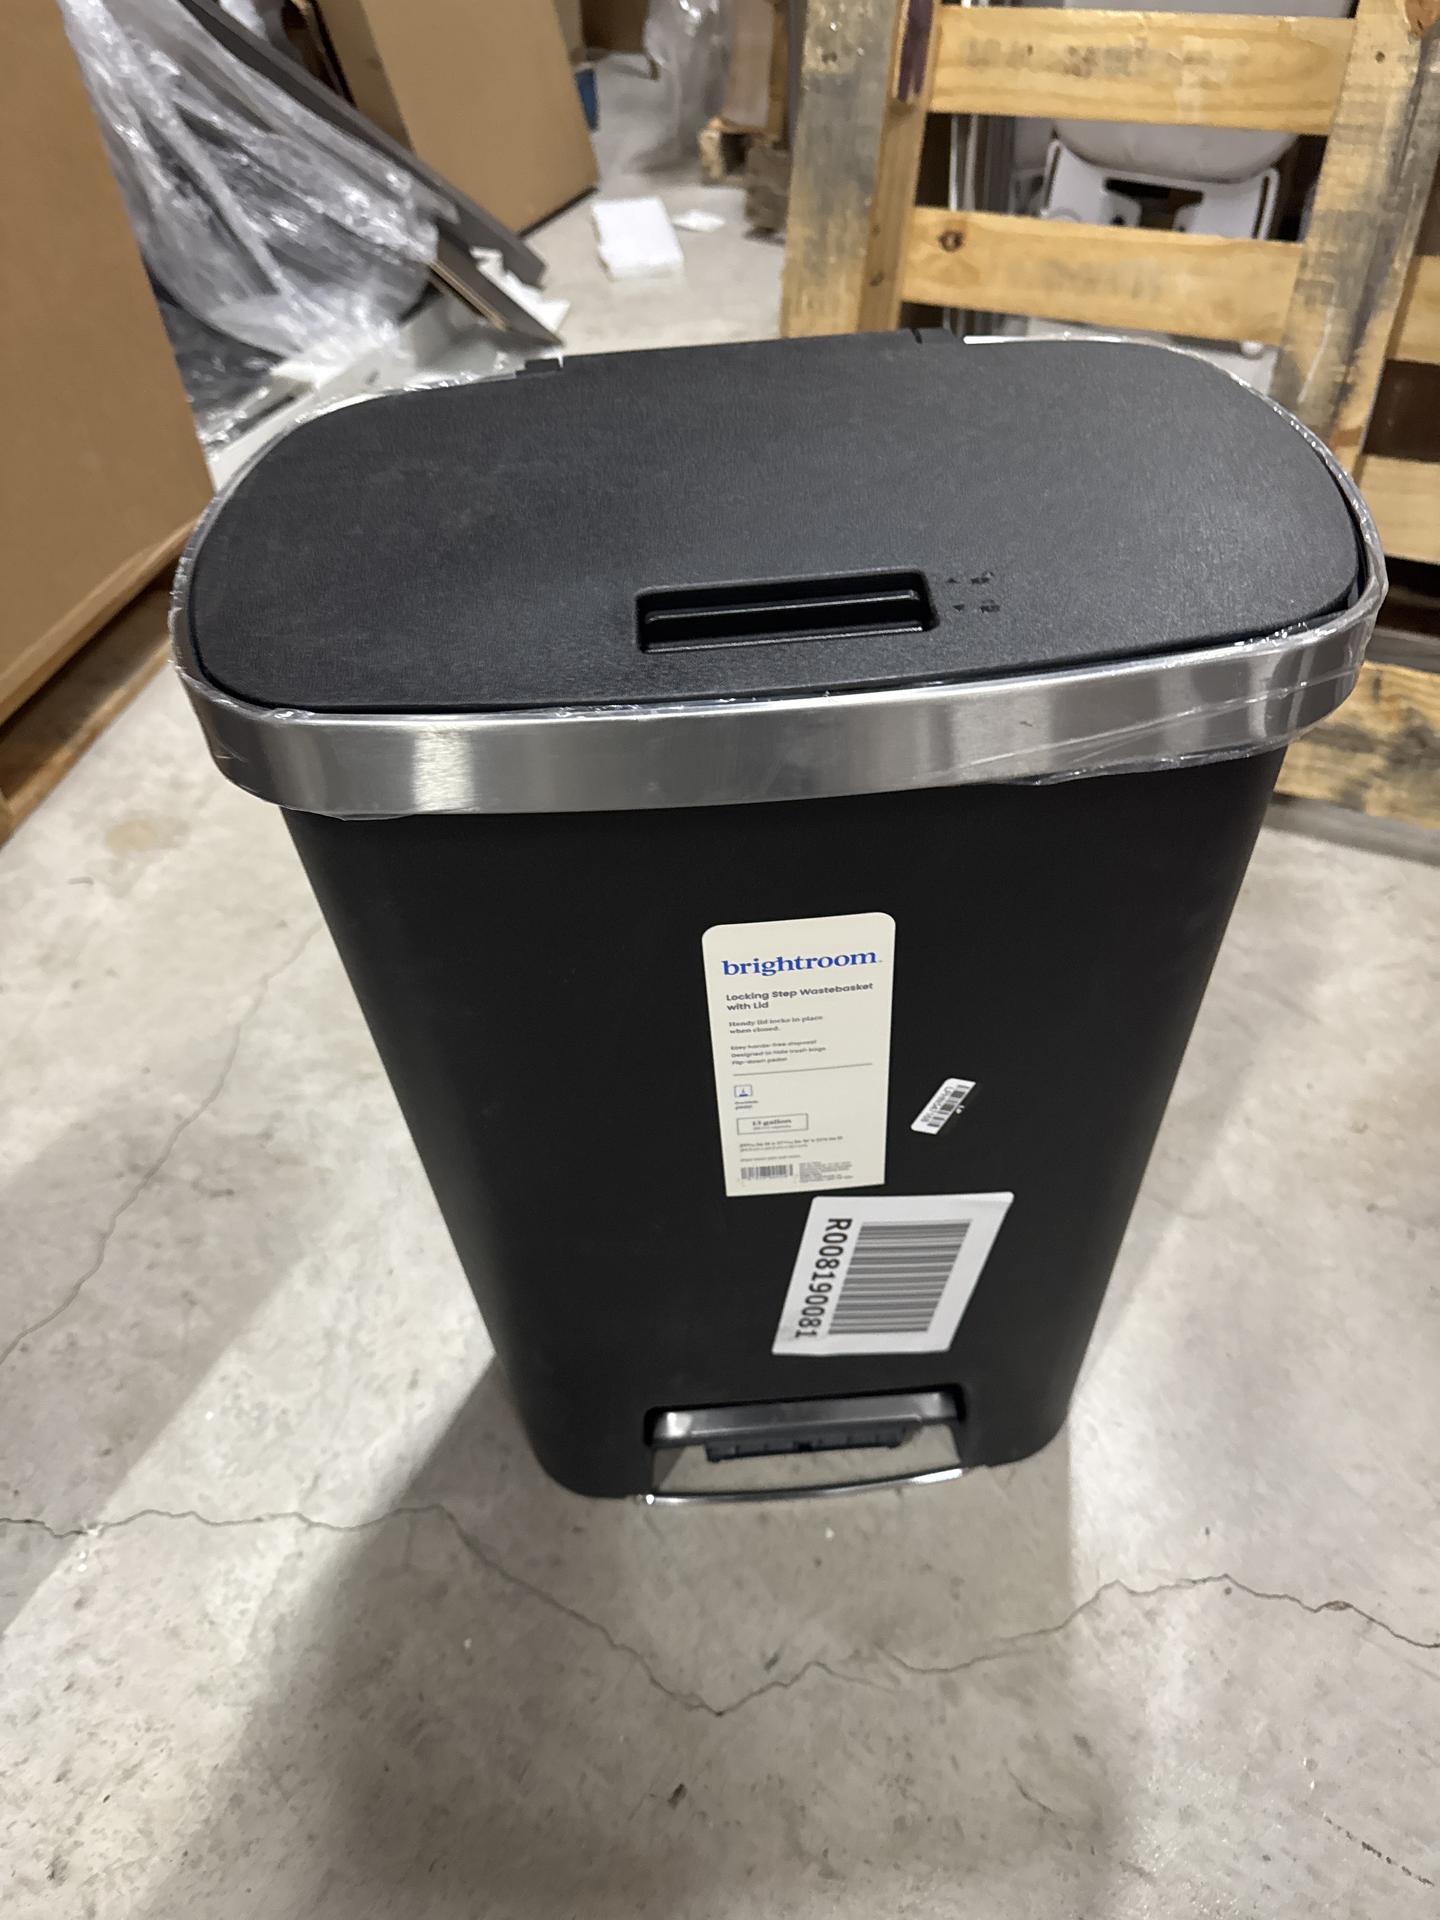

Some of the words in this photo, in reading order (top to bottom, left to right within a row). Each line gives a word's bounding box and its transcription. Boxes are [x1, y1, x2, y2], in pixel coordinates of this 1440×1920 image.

[721, 951, 877, 977] brightroom
[726, 992, 769, 1002] Locking
[772, 990, 797, 999] Step
[800, 983, 873, 996] Wastebasket
[727, 1003, 751, 1011] with
[728, 1020, 755, 1028] Handy
[794, 1218, 853, 1339] R008190081
